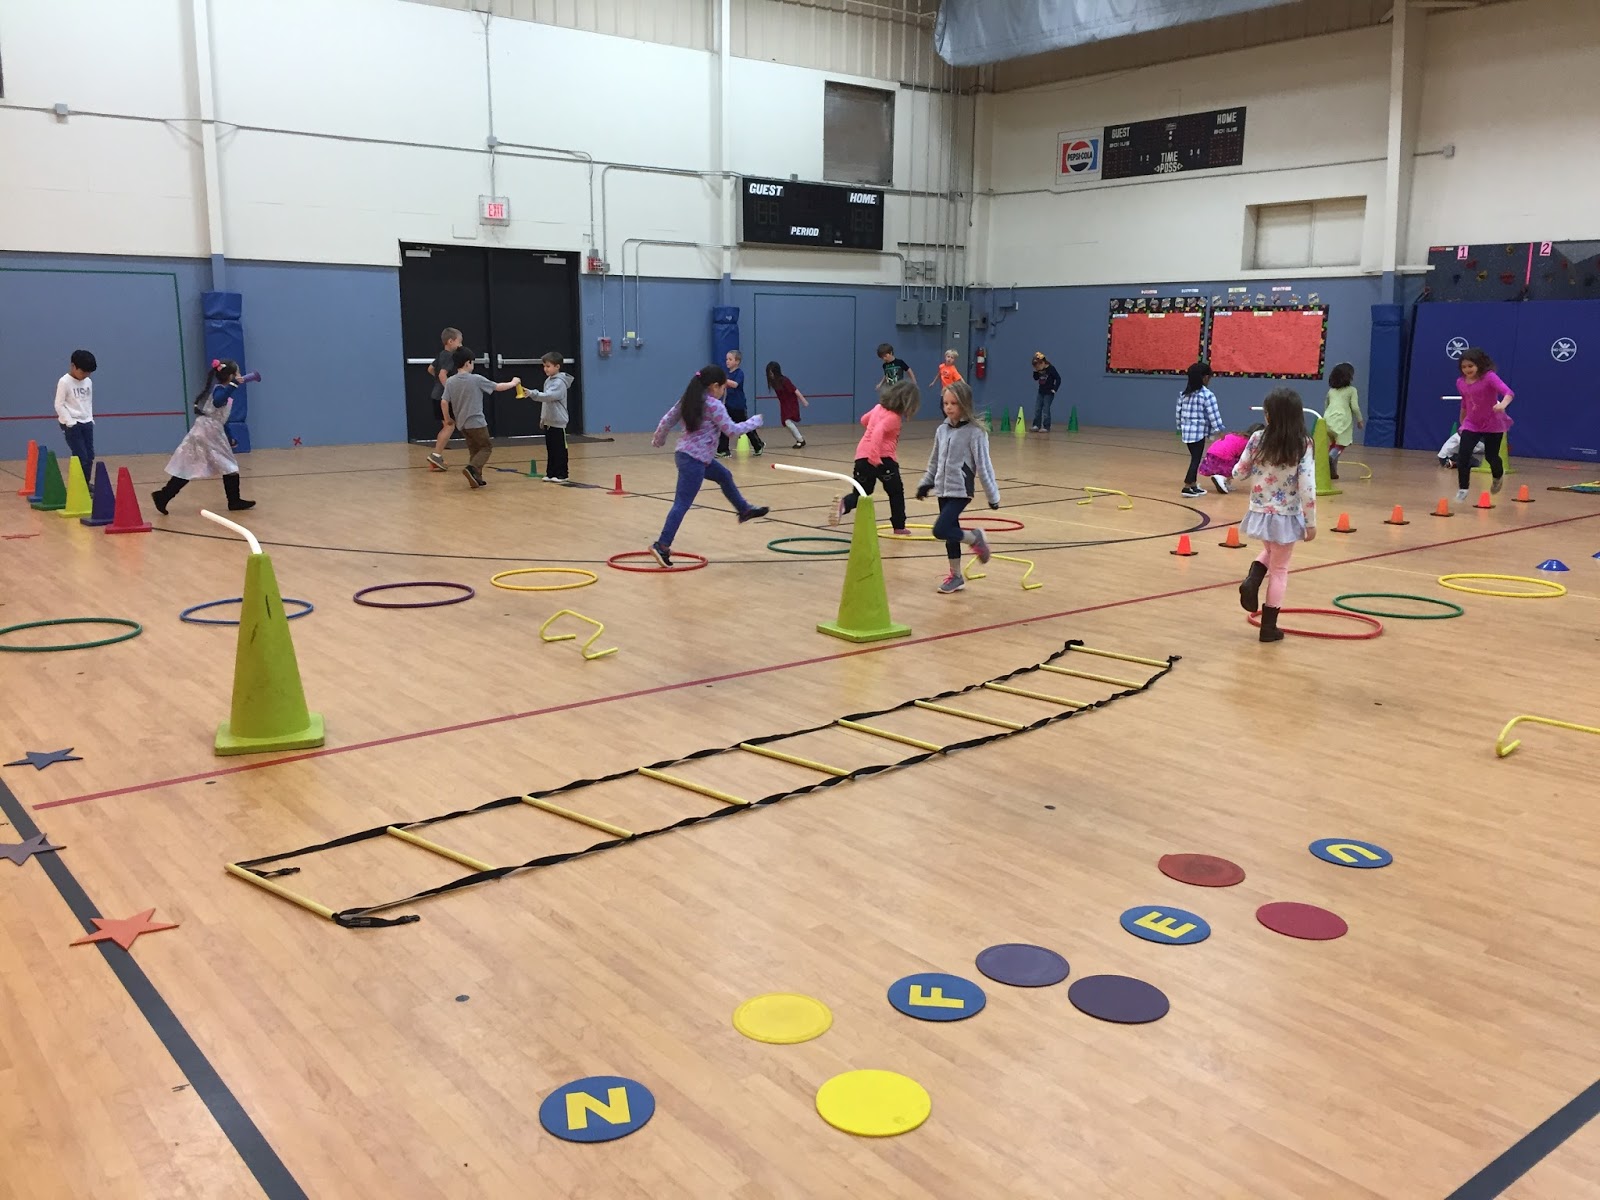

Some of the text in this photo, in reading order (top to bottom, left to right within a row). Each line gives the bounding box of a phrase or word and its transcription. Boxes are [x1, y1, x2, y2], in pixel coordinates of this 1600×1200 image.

[1216, 111, 1237, 125] HOME
[1111, 126, 1130, 139] GUEST
[1160, 150, 1178, 163] TIME
[1160, 161, 1178, 173] POSS
[749, 182, 784, 196] GUEST
[849, 192, 877, 205] HOME
[488, 203, 503, 217] EXIT
[790, 226, 819, 237] PERIOD
[1458, 246, 1468, 259] 1
[1541, 242, 1550, 255] 2
[1133, 911, 1198, 939] E
[908, 984, 965, 1009] F
[565, 1086, 632, 1131] N
